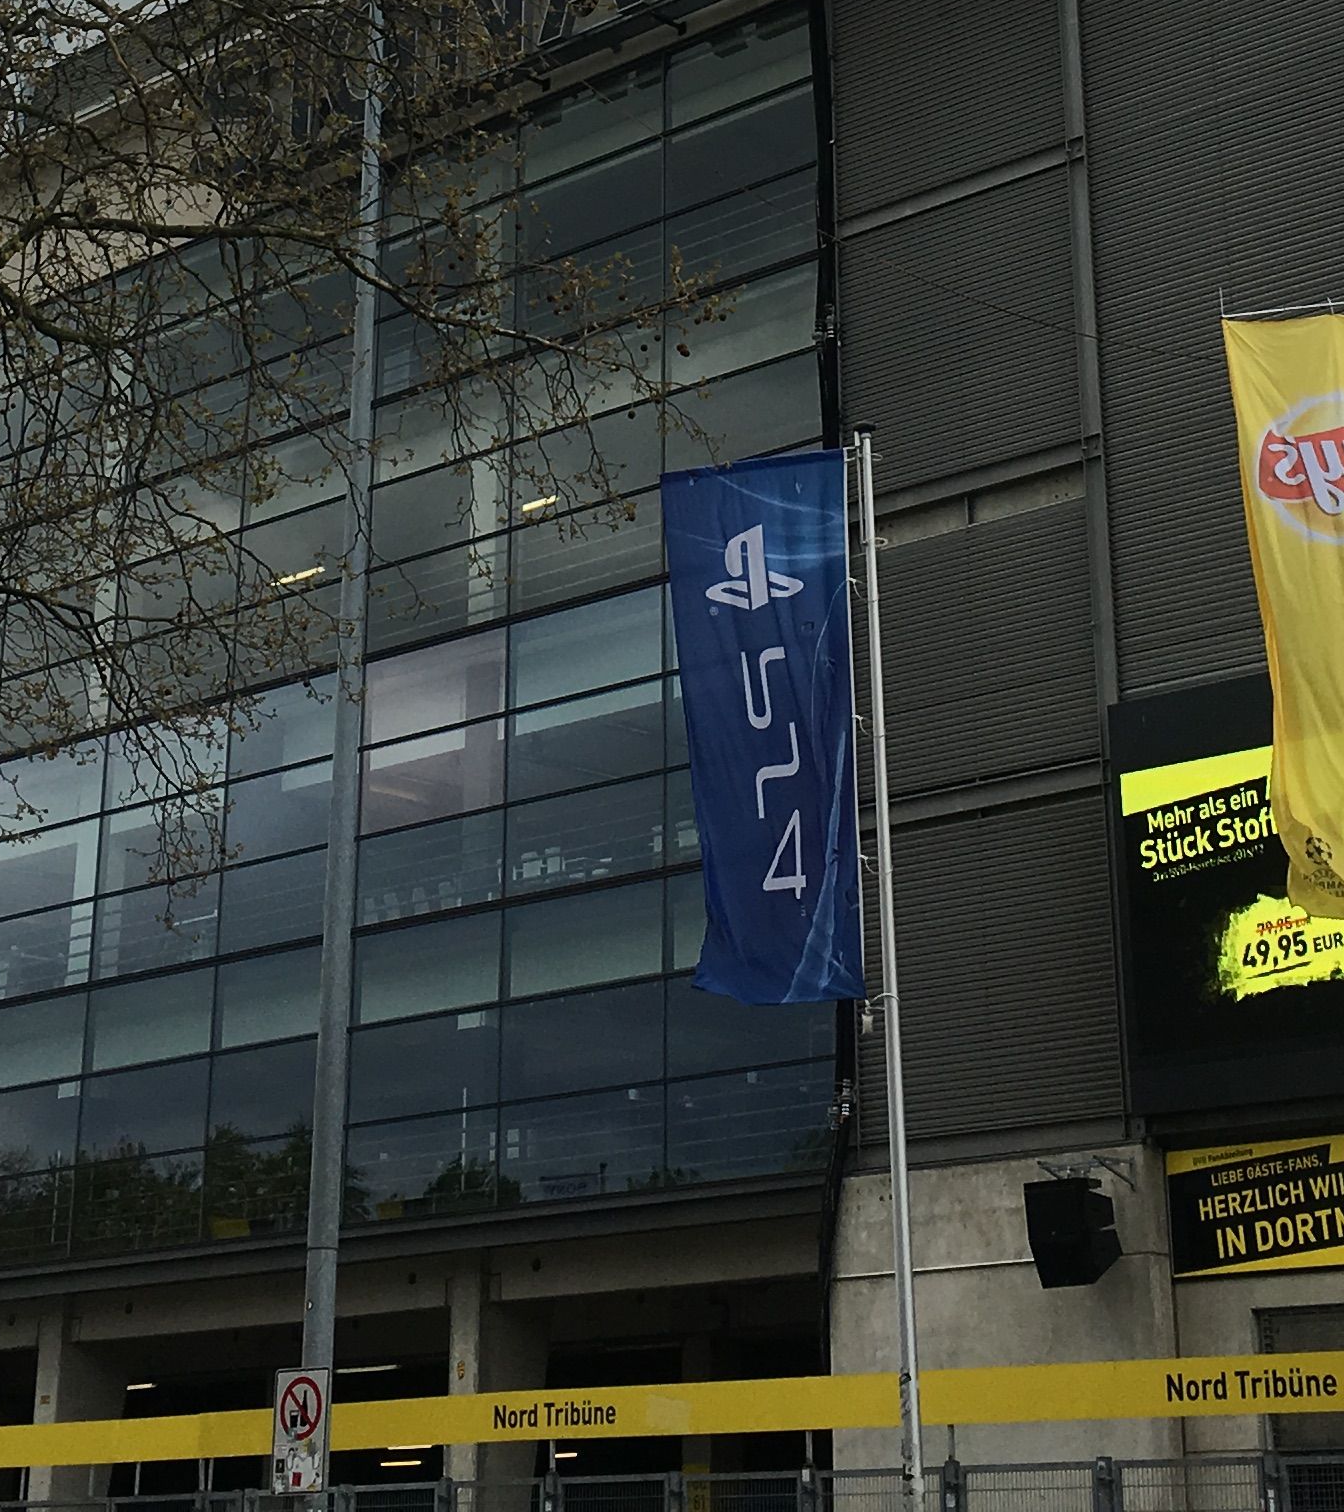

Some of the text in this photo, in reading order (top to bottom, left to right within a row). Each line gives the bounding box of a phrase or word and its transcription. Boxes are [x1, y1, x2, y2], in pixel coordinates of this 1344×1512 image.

[1147, 788, 1258, 834] Mehr als ein
[1140, 824, 1213, 869] Stück
[1242, 929, 1344, 969] 49,95 EUR
[1211, 1168, 1245, 1187] LIEBE
[1198, 1178, 1306, 1222] HERZLICH
[1215, 1225, 1247, 1260] IN
[1166, 1368, 1338, 1403] Nord Tribüne
[492, 1400, 617, 1430] Nord Tribüne
